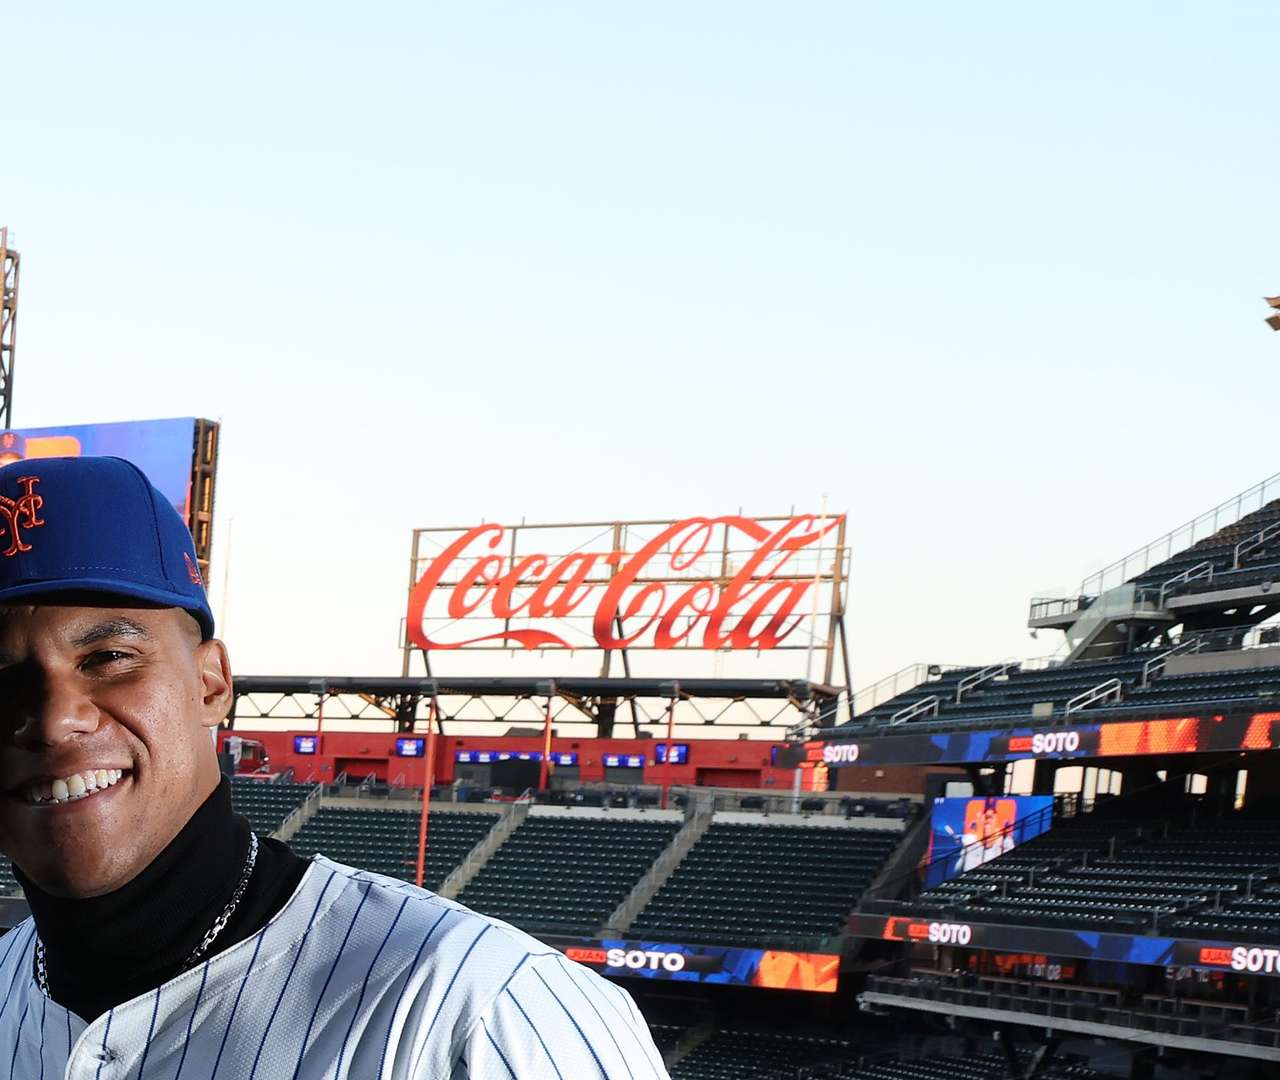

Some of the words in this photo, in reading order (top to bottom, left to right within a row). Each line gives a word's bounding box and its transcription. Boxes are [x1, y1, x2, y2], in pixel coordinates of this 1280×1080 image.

[822, 743, 859, 763] SOTO
[1031, 731, 1080, 754] SOTO
[928, 922, 972, 945] SOTO
[606, 948, 686, 972] SOTO
[1231, 946, 1280, 974] SOT
